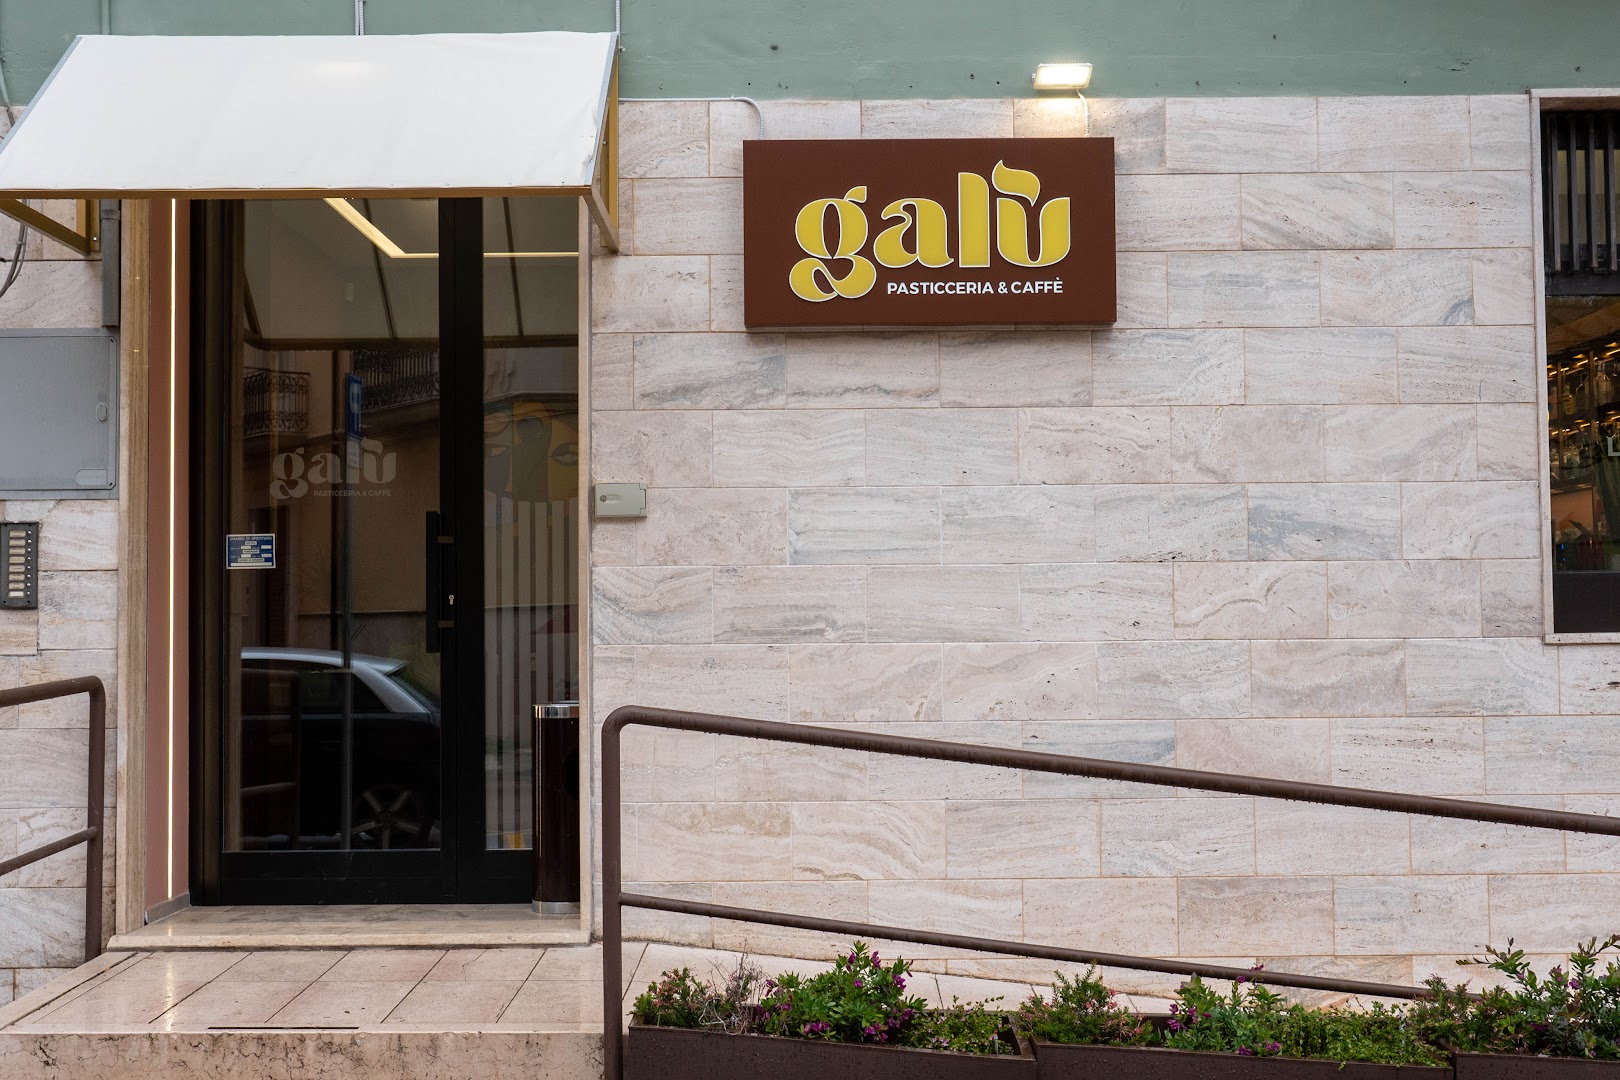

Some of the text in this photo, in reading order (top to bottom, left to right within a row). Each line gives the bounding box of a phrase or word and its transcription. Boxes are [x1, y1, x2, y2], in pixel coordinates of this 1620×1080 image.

[788, 159, 1071, 302] galù
[887, 276, 1064, 295] PASTICCERIA & CAFFÈ
[269, 436, 397, 500] galù
